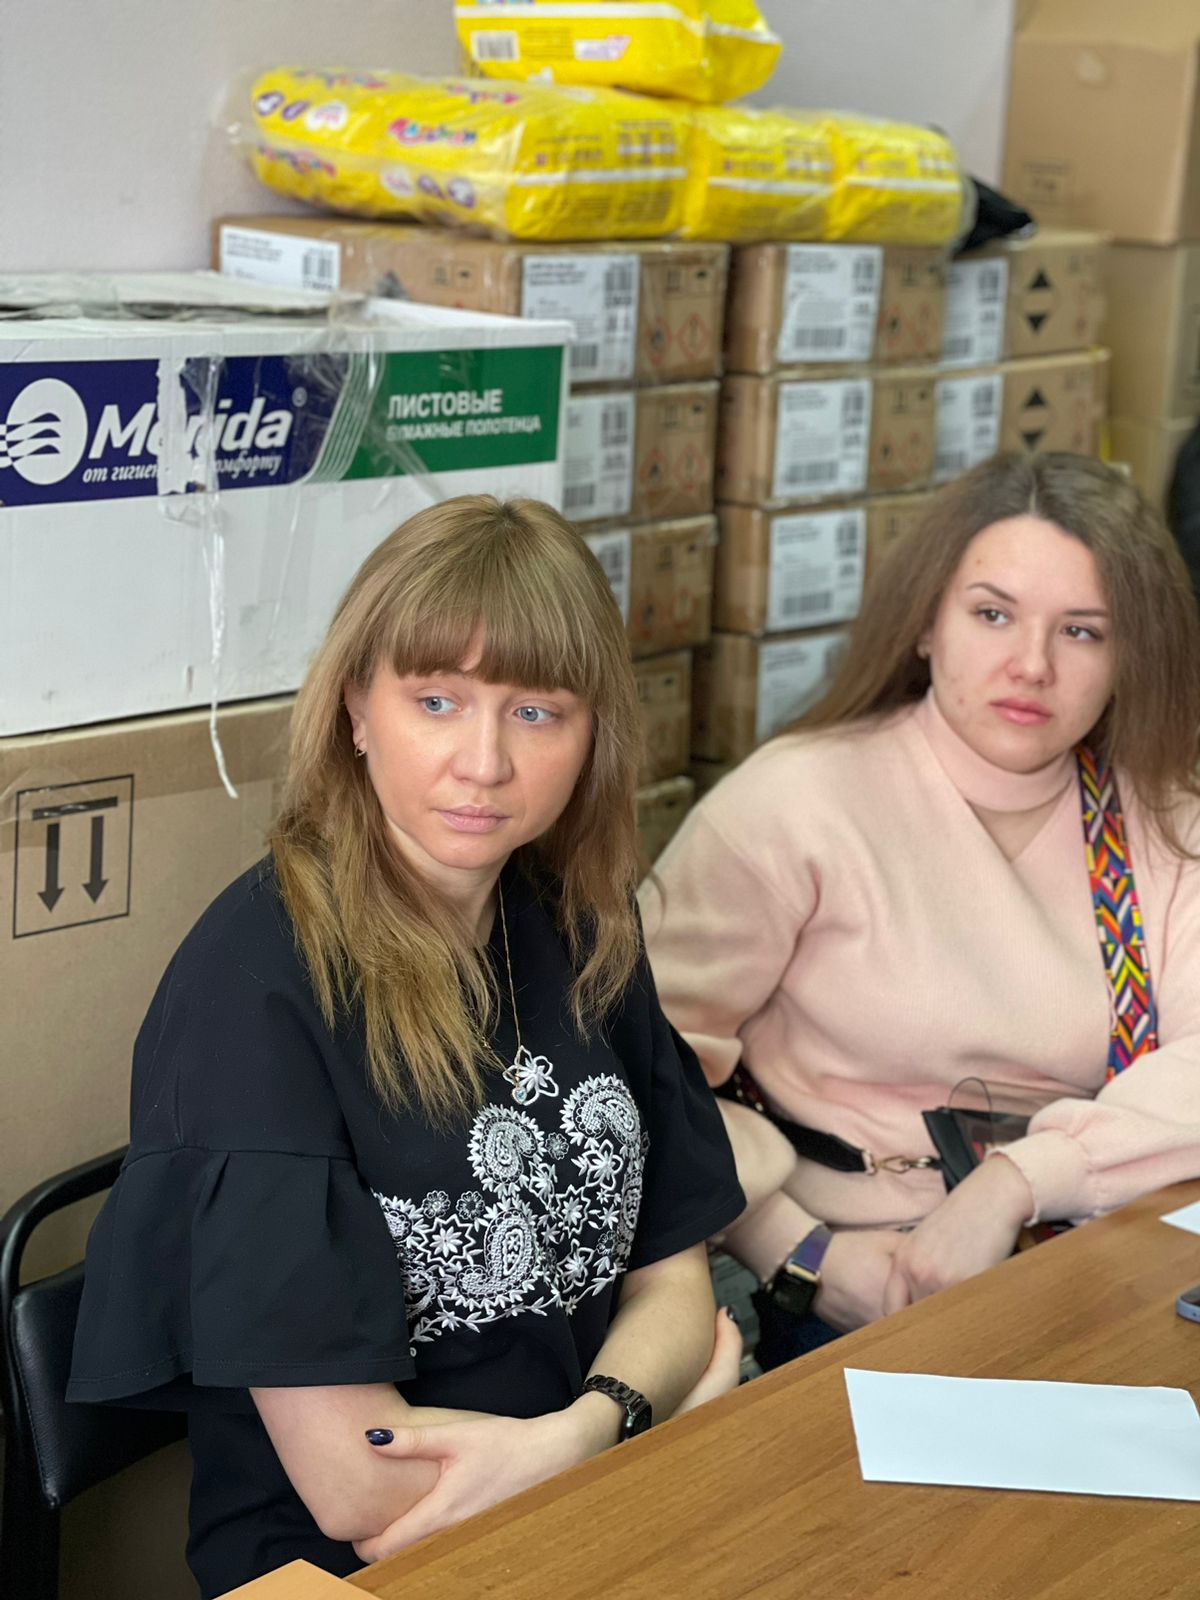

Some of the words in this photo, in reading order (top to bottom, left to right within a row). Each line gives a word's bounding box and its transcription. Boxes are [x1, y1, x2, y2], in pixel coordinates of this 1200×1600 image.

[387, 388, 504, 419] ЛИСТОВЫЕ
[82, 466, 108, 483] от
[111, 463, 159, 481] гигиен
[213, 449, 283, 480] омфорту
